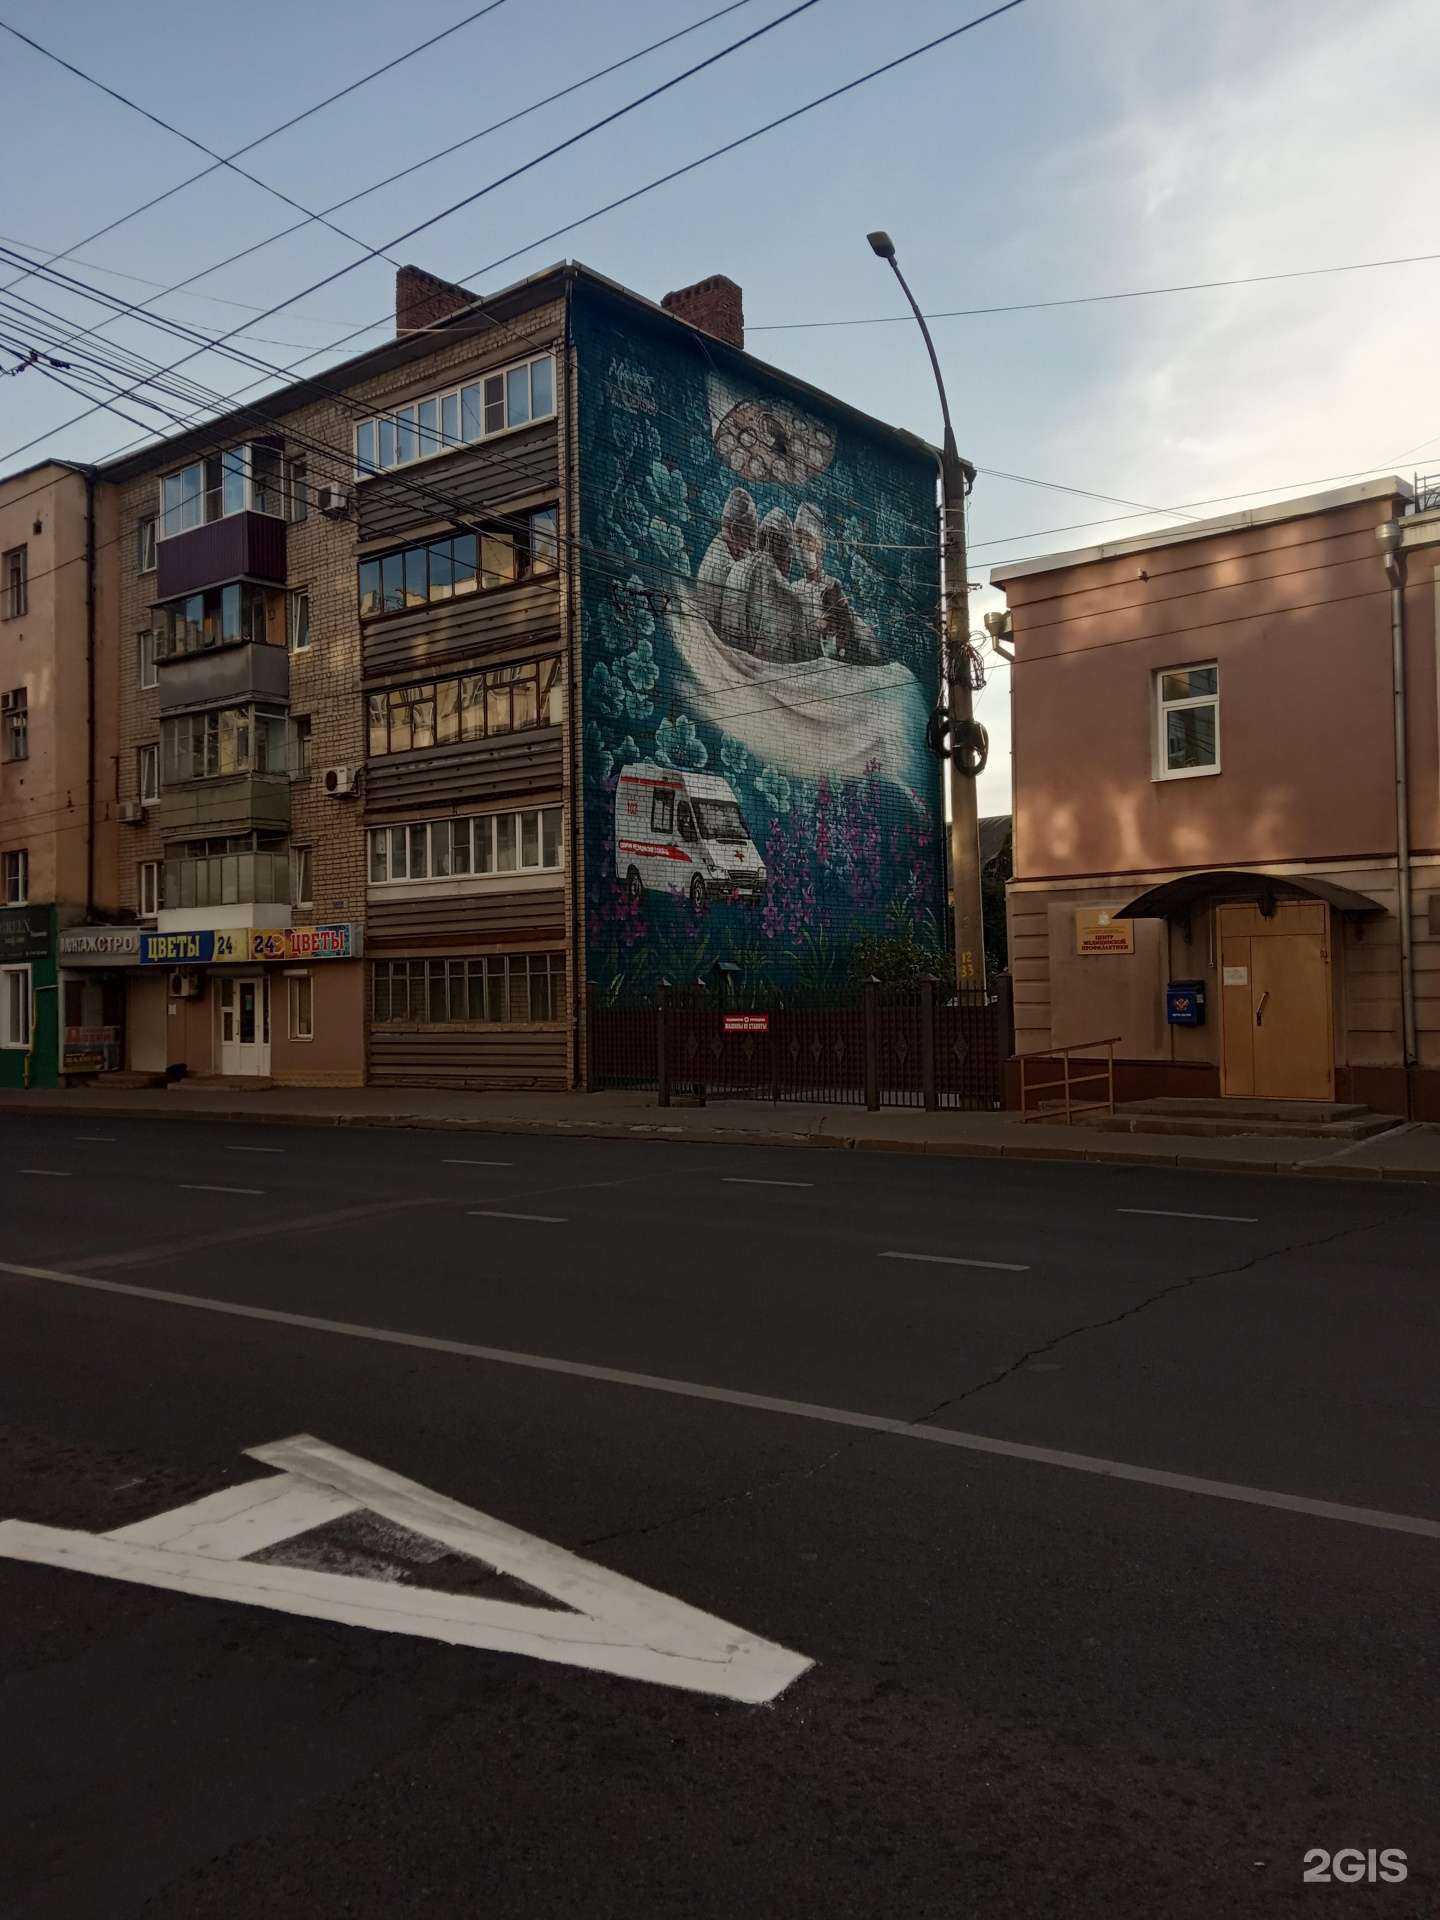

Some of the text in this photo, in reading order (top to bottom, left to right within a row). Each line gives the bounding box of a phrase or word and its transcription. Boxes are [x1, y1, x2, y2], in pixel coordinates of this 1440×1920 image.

[147, 935, 232, 960] ЦВЕТЫ 24
[254, 930, 345, 954] 24 ЦВЕТЫ
